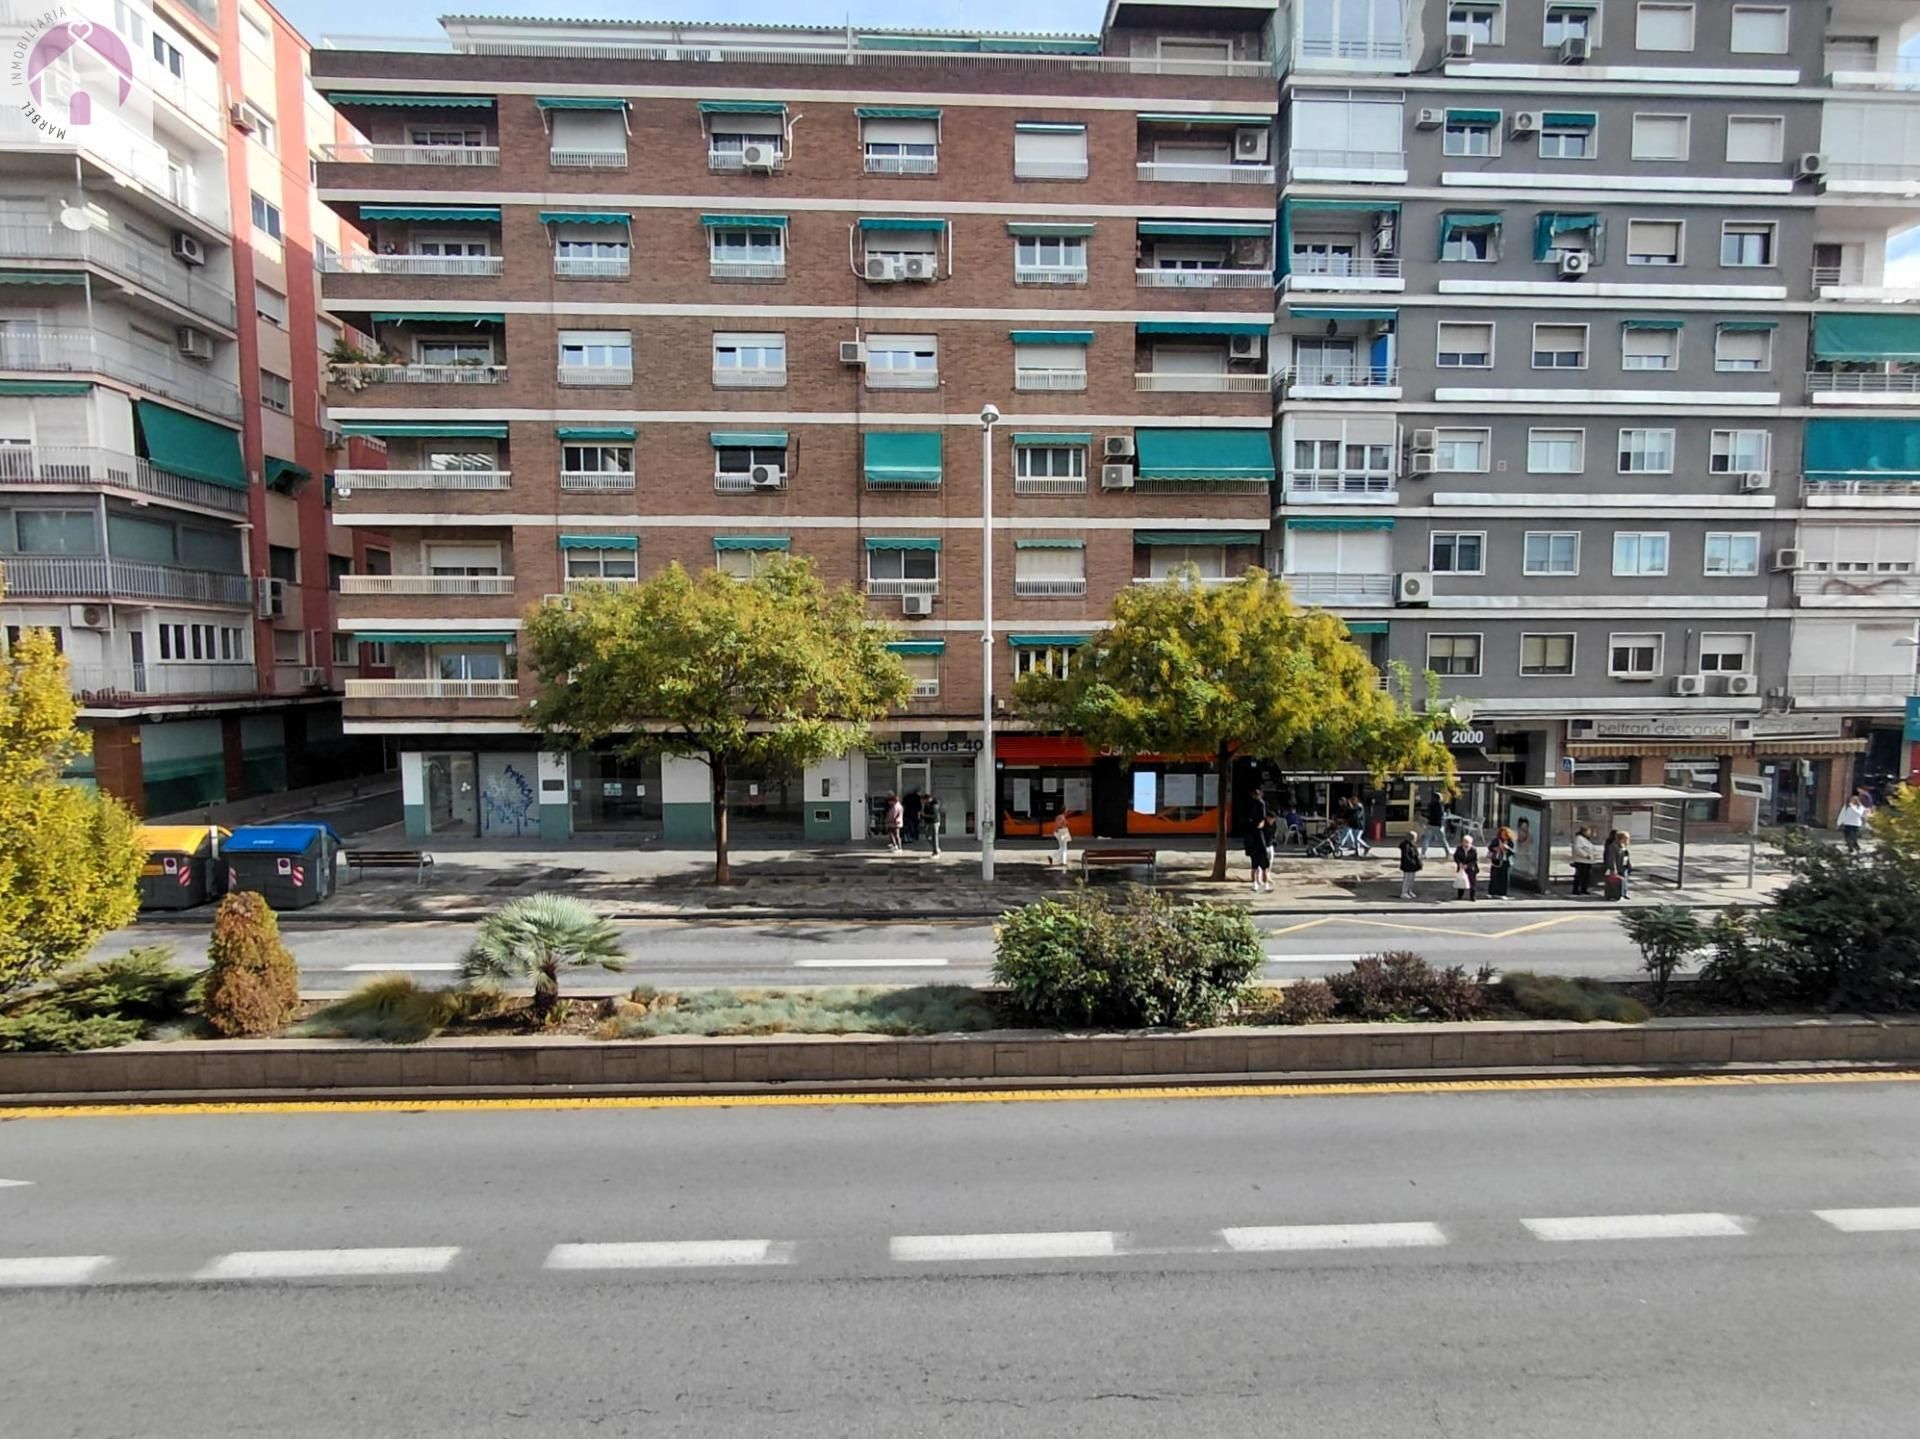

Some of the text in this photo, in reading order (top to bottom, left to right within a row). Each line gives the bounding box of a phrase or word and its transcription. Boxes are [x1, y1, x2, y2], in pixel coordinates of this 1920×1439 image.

[1597, 722, 1729, 736] beltran descanso
[1451, 730, 1484, 743] 2000
[911, 740, 958, 752] Ronda
[964, 739, 984, 752] 40
